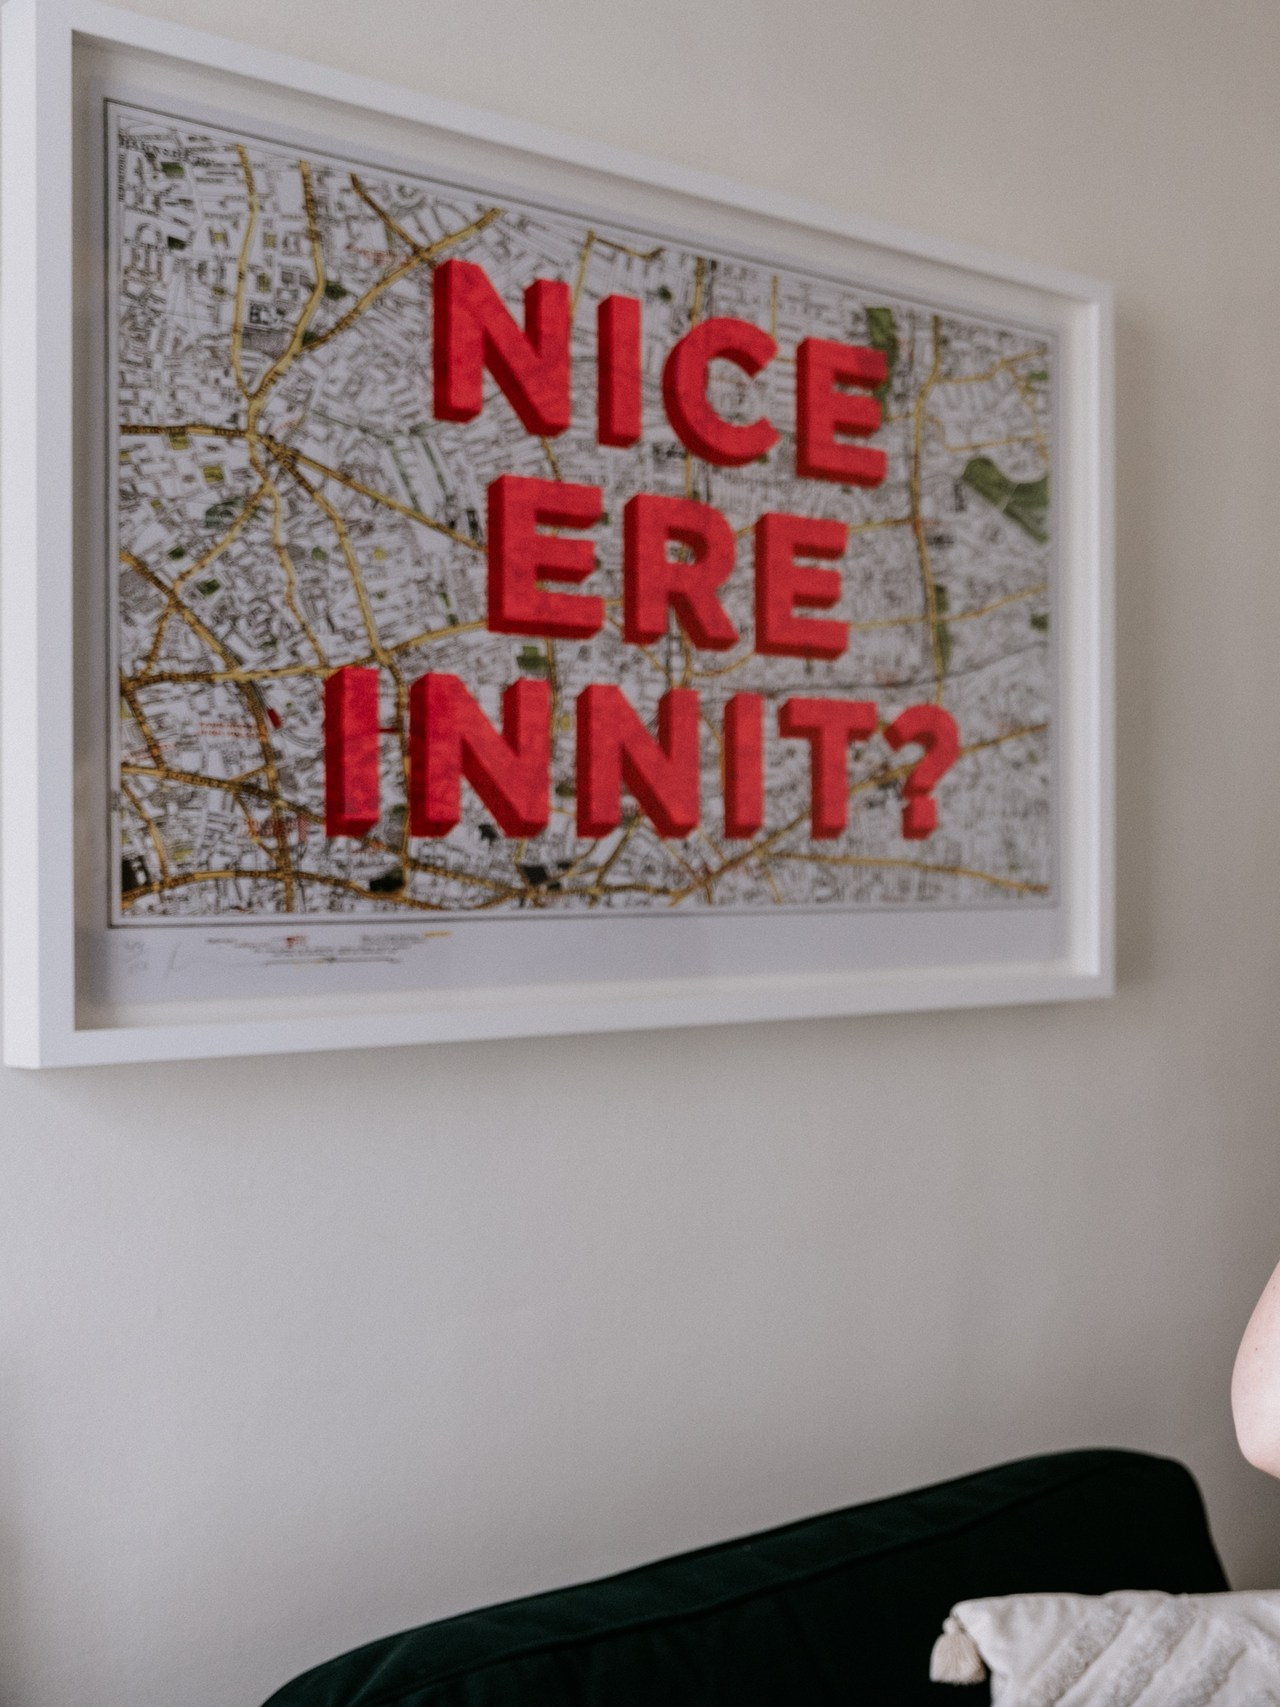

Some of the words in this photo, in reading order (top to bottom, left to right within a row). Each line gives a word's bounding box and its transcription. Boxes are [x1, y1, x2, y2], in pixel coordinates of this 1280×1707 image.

[431, 258, 888, 488] NICE
[485, 473, 851, 660] ERE
[322, 664, 961, 840] INNIT?
